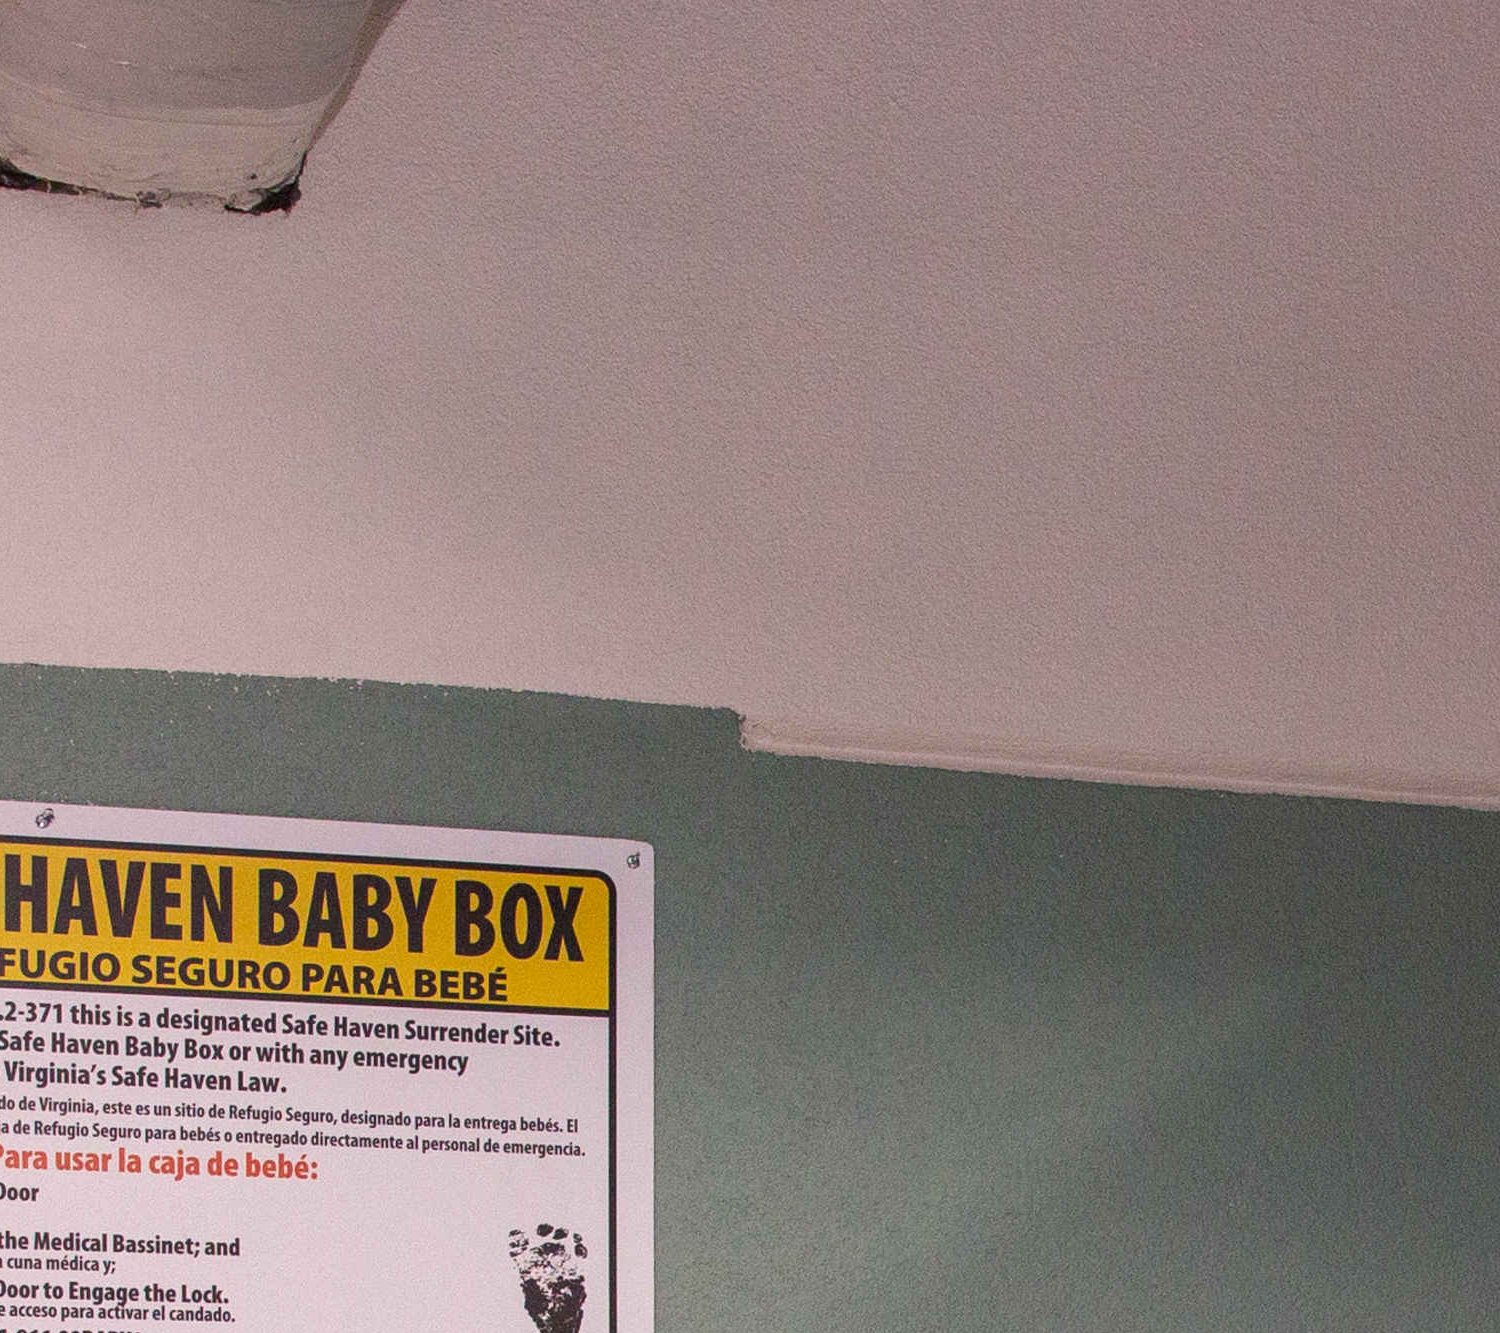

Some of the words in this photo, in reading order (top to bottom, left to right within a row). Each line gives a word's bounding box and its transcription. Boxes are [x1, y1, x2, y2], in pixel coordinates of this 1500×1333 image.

[4, 854, 233, 943] HAVEN
[258, 868, 437, 953] BABY
[455, 879, 584, 962] BOX
[132, 954, 290, 991] SEGURO
[302, 963, 403, 996] PARA
[414, 966, 507, 1002] BEBÉ
[70, 1004, 111, 1026] this
[117, 1005, 133, 1027] is
[138, 1012, 151, 1028] a
[156, 1008, 276, 1036] designated
[282, 1014, 328, 1036] Safe
[334, 1016, 399, 1039] Haven
[405, 1020, 509, 1044] Surrender
[513, 1025, 560, 1047] Site.
[112, 1065, 159, 1088] Safe
[165, 1068, 231, 1091] Haven
[238, 1071, 287, 1093] Law.
[55, 1152, 112, 1172] usar
[119, 1147, 141, 1173] la
[149, 1149, 200, 1181] caja
[207, 1151, 239, 1177] de
[246, 1152, 318, 1180] bebé:
